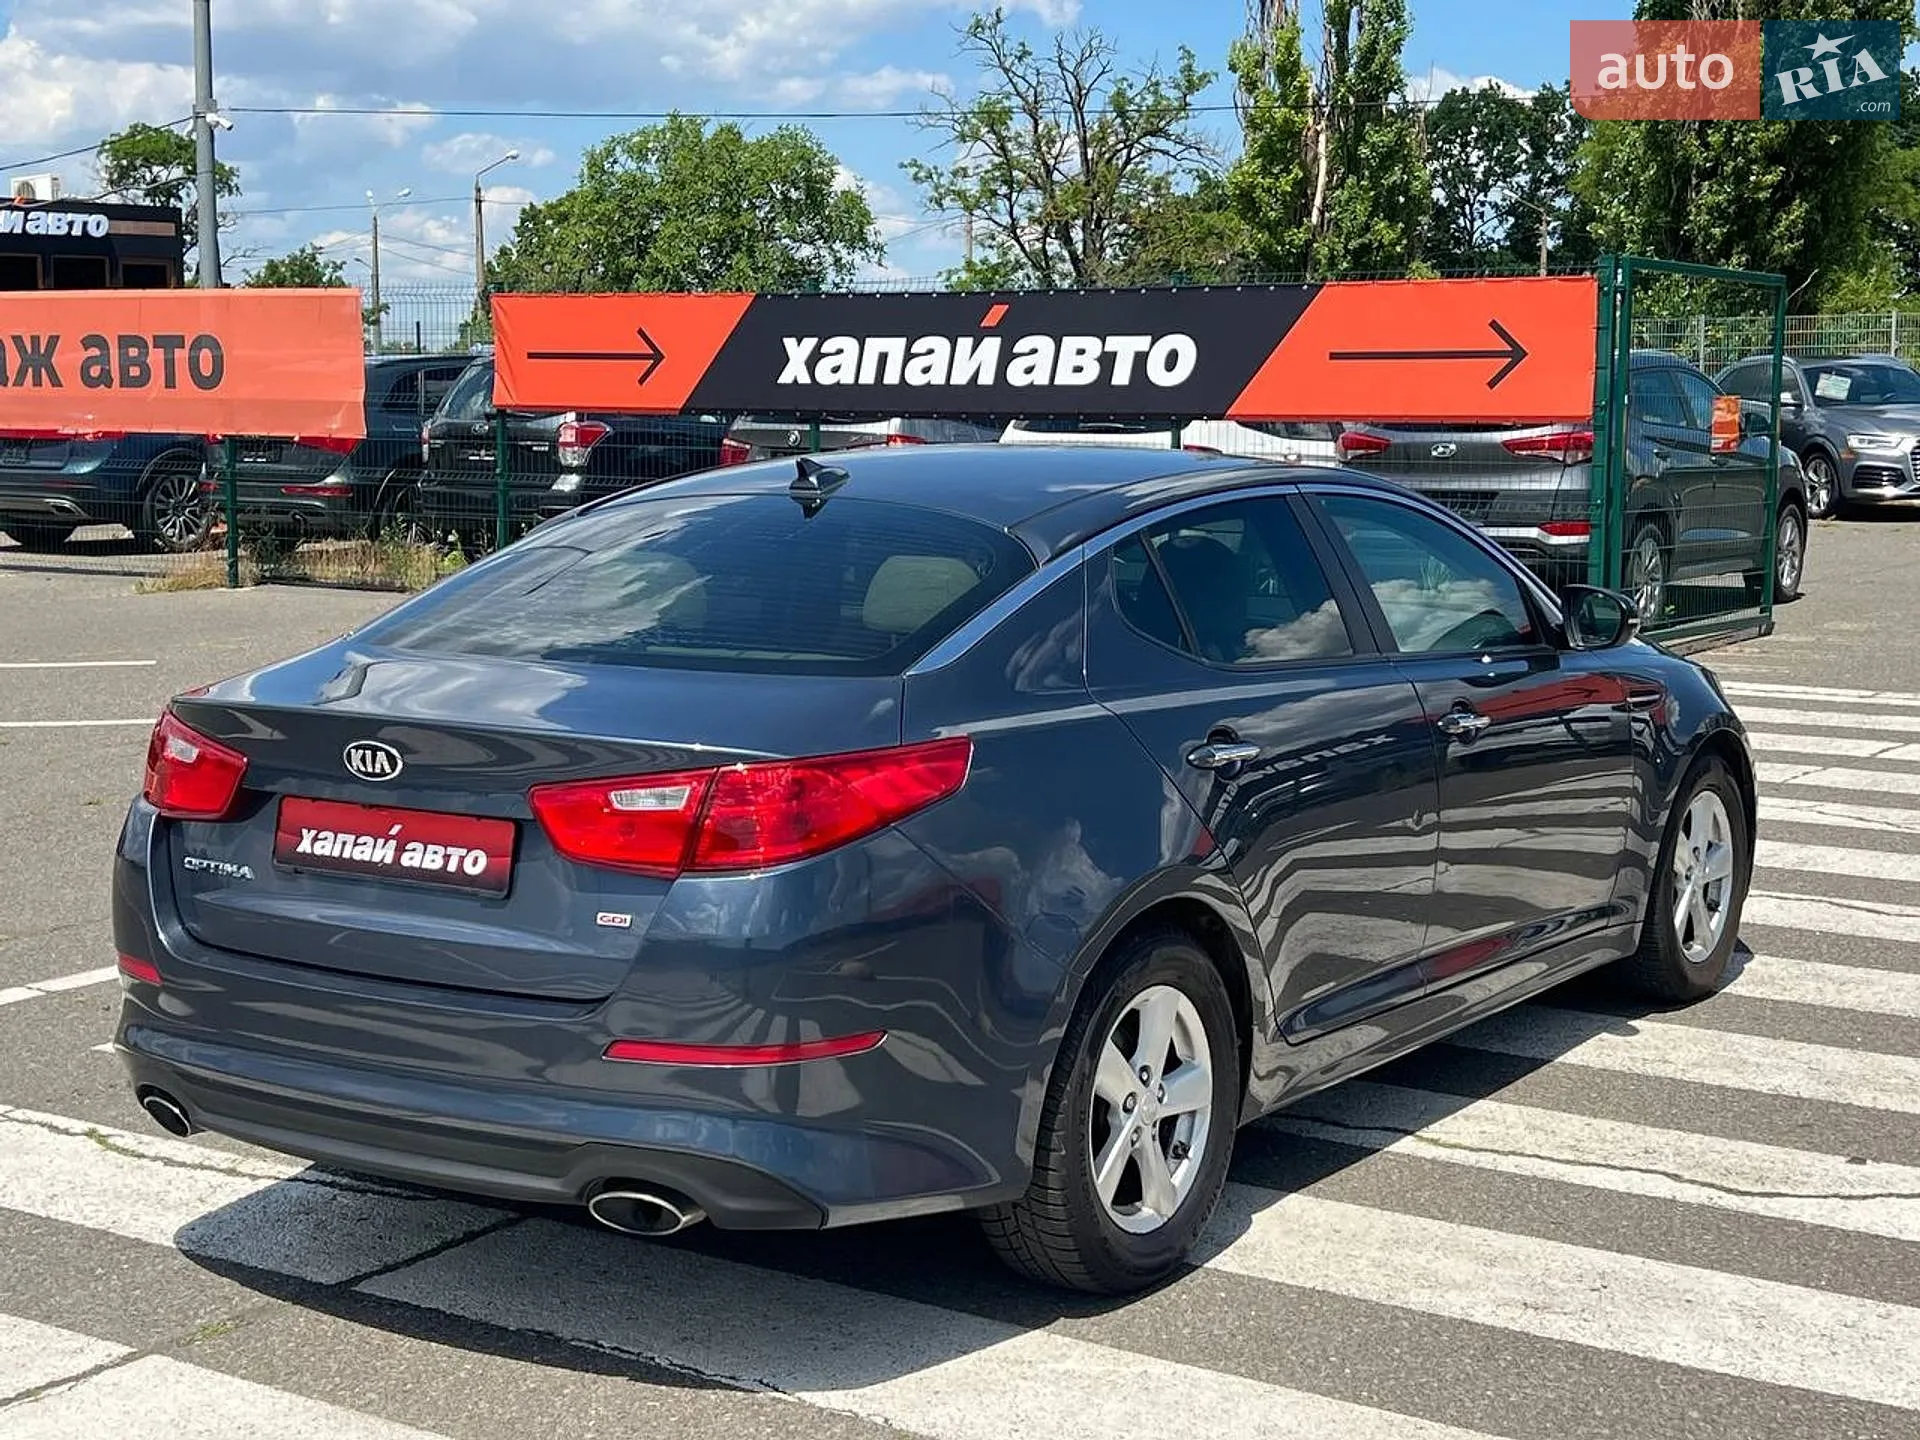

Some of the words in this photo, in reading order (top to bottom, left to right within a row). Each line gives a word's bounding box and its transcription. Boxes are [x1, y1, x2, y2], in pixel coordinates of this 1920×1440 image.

[25, 211, 110, 238] авто
[80, 334, 225, 391] авто
[777, 304, 1009, 387] хапай
[1005, 333, 1198, 388] авто
[350, 748, 393, 774] KIA
[295, 824, 403, 865] хапай
[399, 841, 488, 876] авто
[599, 914, 628, 925] GDI
